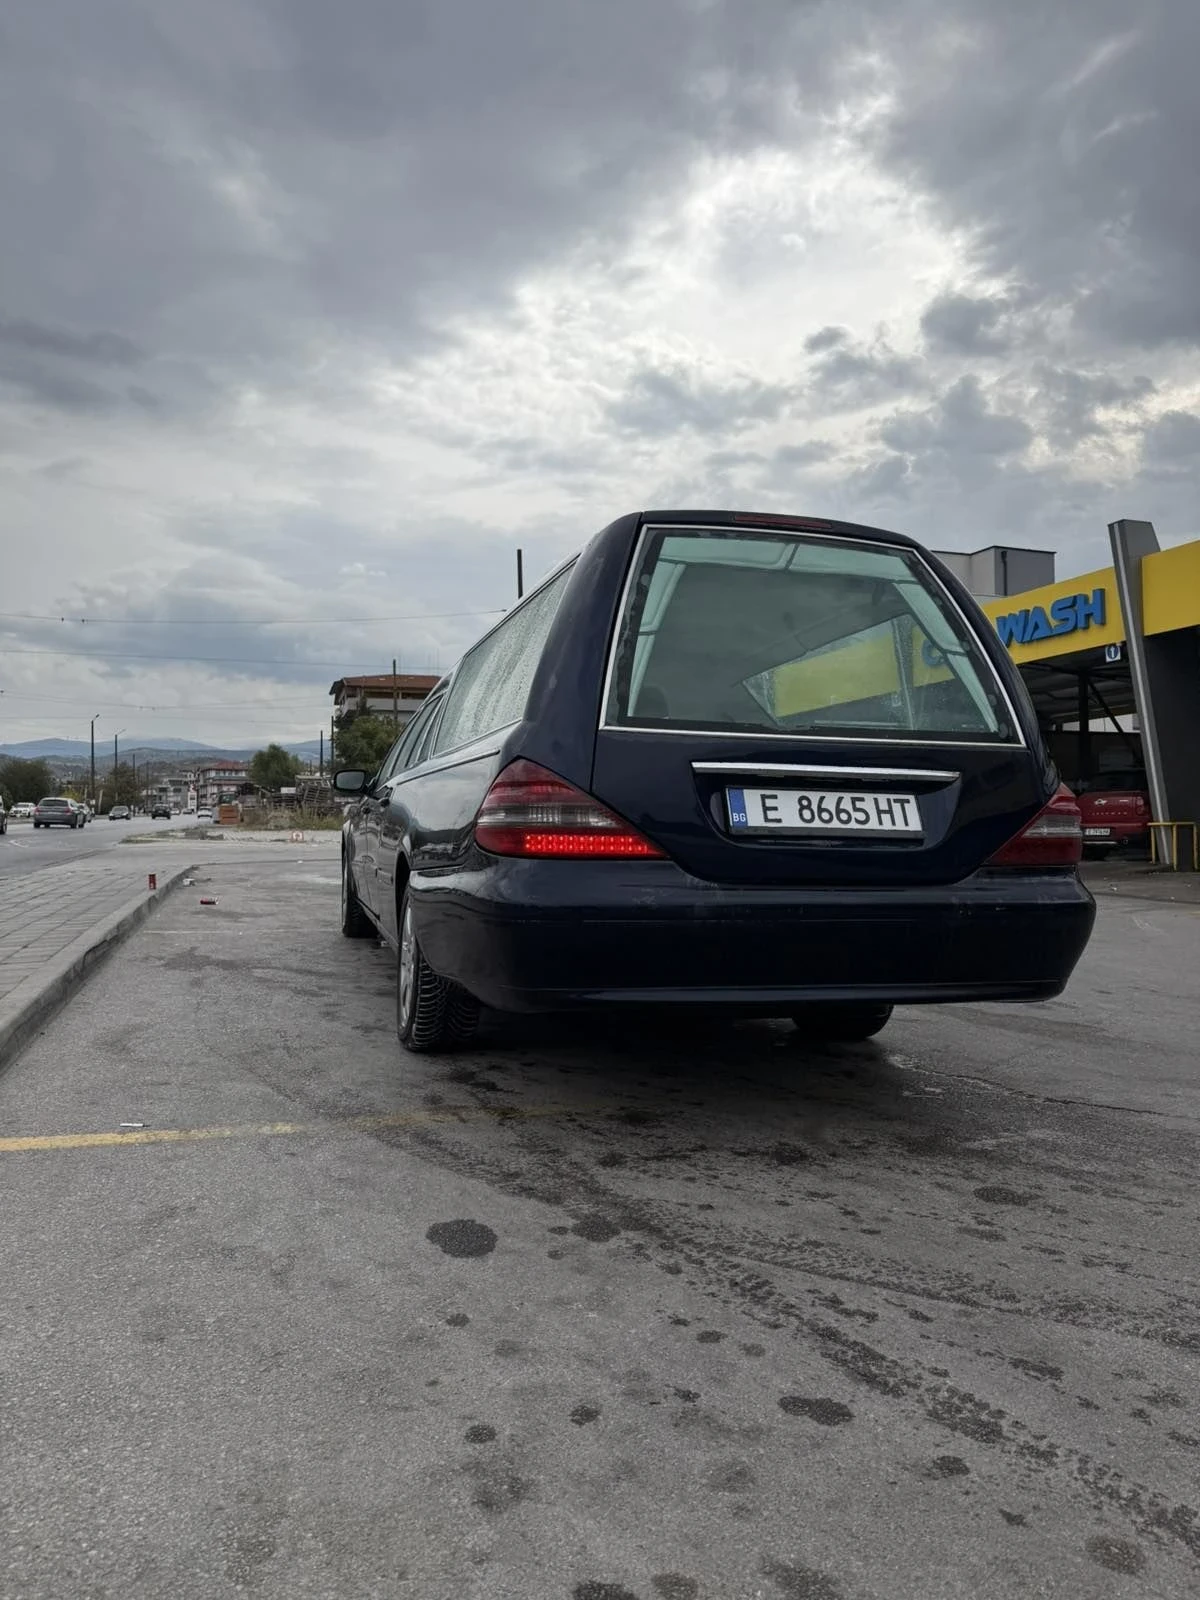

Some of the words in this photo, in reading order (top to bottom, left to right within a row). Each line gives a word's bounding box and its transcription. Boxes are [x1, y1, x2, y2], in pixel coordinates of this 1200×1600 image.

[996, 588, 1106, 648] WASH
[733, 813, 747, 823] BG
[760, 794, 782, 824] E
